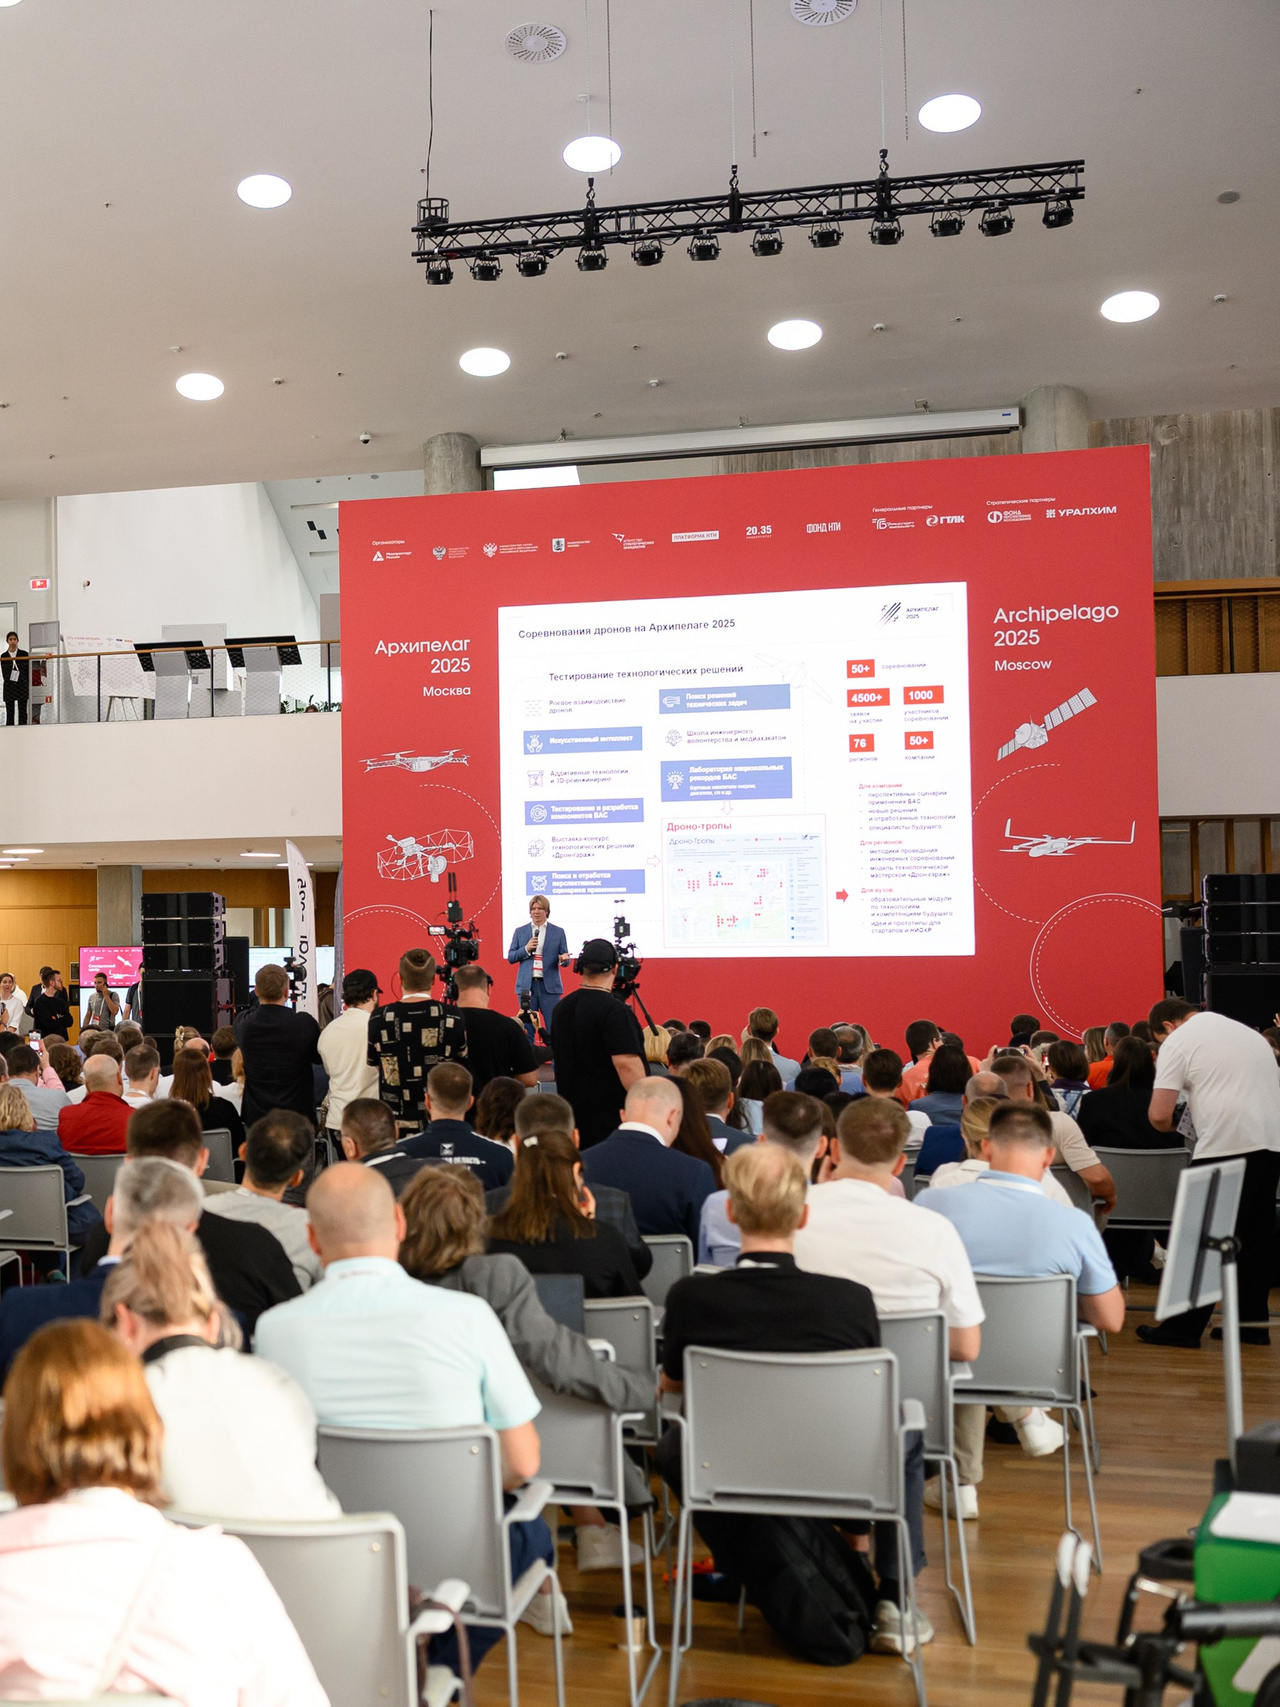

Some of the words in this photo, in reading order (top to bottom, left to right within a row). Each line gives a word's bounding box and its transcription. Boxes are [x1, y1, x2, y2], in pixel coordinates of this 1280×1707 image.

[1058, 506, 1117, 517] УРАЛХИМ
[939, 515, 965, 524] ГТЛК
[746, 525, 772, 536] 20.35
[806, 523, 827, 534] ФОНД
[828, 522, 841, 532] НТИ
[673, 533, 705, 541] ПЛАТФОРМА
[706, 532, 718, 540] НТИ
[993, 604, 1119, 625] Archipelago
[518, 627, 591, 640] Соревнования
[593, 625, 632, 636] дронов
[634, 624, 646, 633] на
[648, 620, 709, 633] Архипелаге
[712, 619, 736, 629] 2025
[994, 629, 1040, 647] 2025
[374, 639, 471, 657] Архипелаг
[430, 657, 471, 674] 2025
[851, 664, 870, 674] 50+
[994, 660, 1052, 671] Moscow
[549, 671, 614, 682] Тестирование
[617, 667, 698, 679] технологических
[700, 664, 743, 676] решений
[423, 686, 471, 697] Москва
[908, 690, 933, 700] 1000
[851, 693, 883, 703] 4500+
[853, 738, 867, 748] 76
[909, 735, 928, 746] 50+
[666, 822, 732, 832] Дроно-тропы
